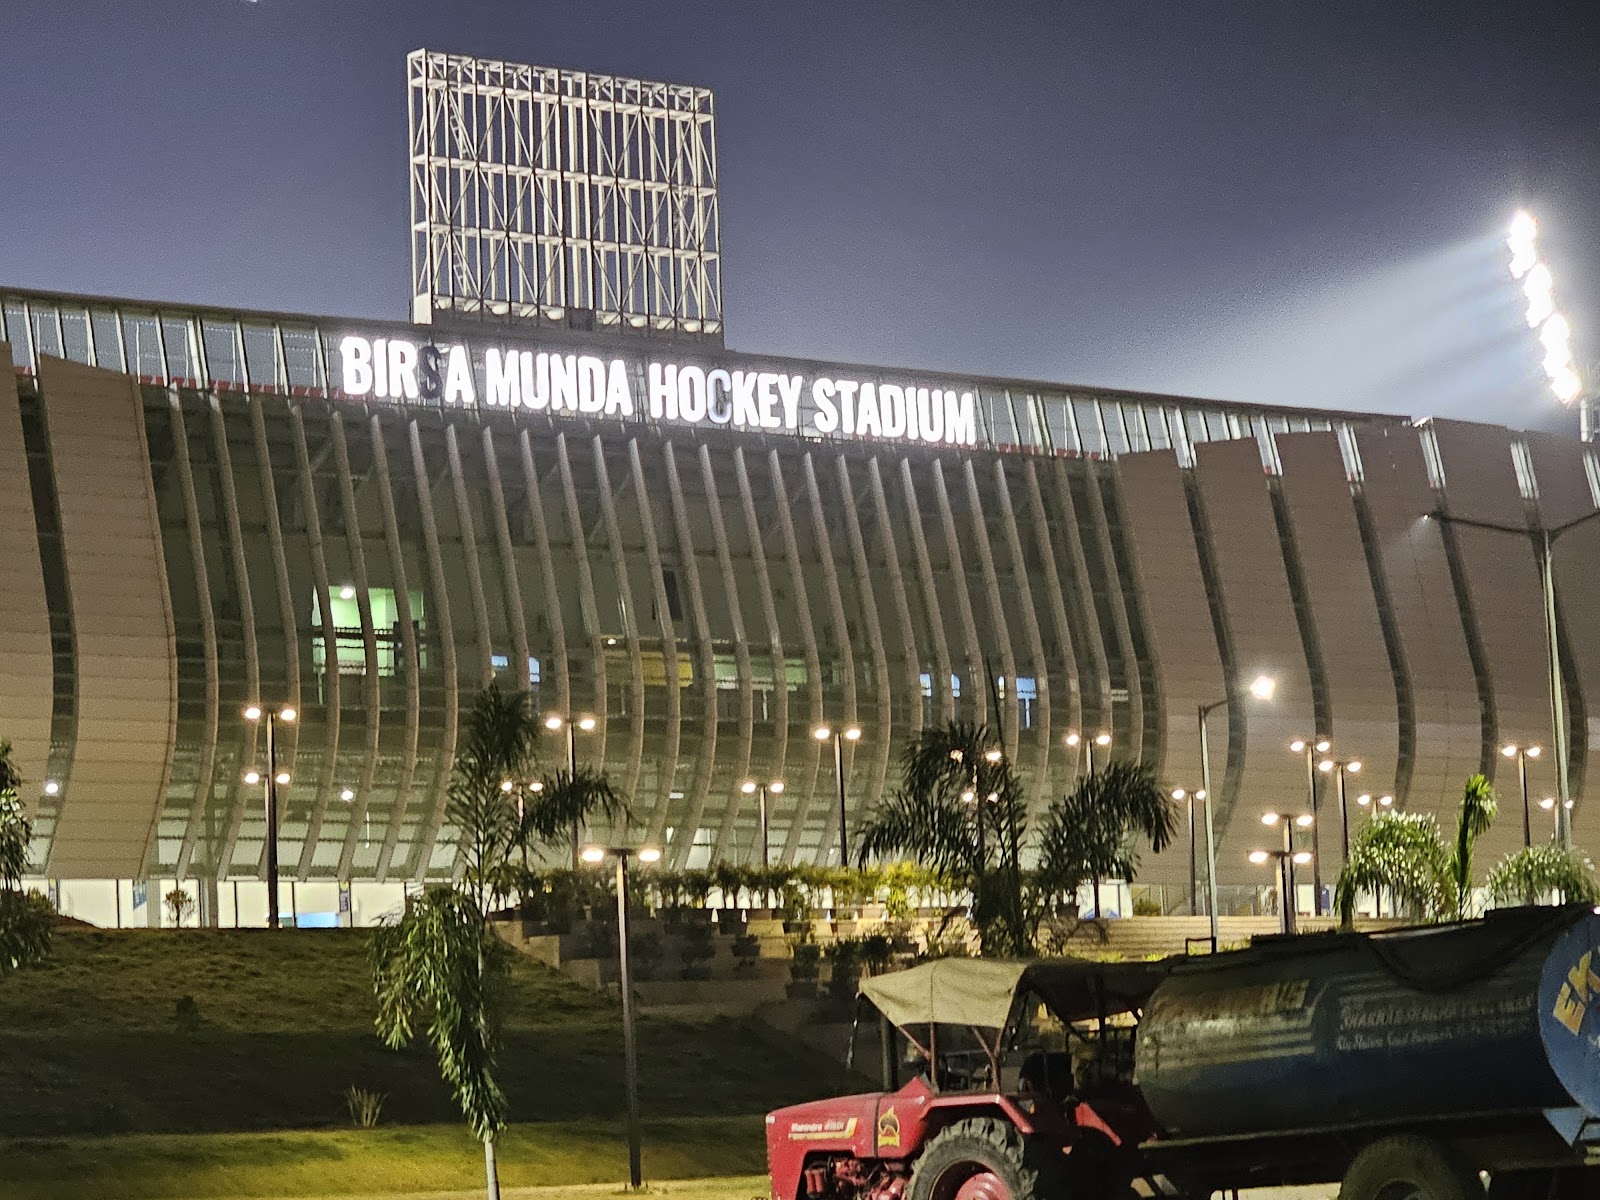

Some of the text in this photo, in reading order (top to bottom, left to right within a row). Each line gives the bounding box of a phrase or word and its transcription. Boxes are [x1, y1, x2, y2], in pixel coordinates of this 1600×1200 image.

[340, 336, 977, 446] BIRSA MUNDA HOCKEY STADIUM
[1552, 946, 1600, 1037] EK
